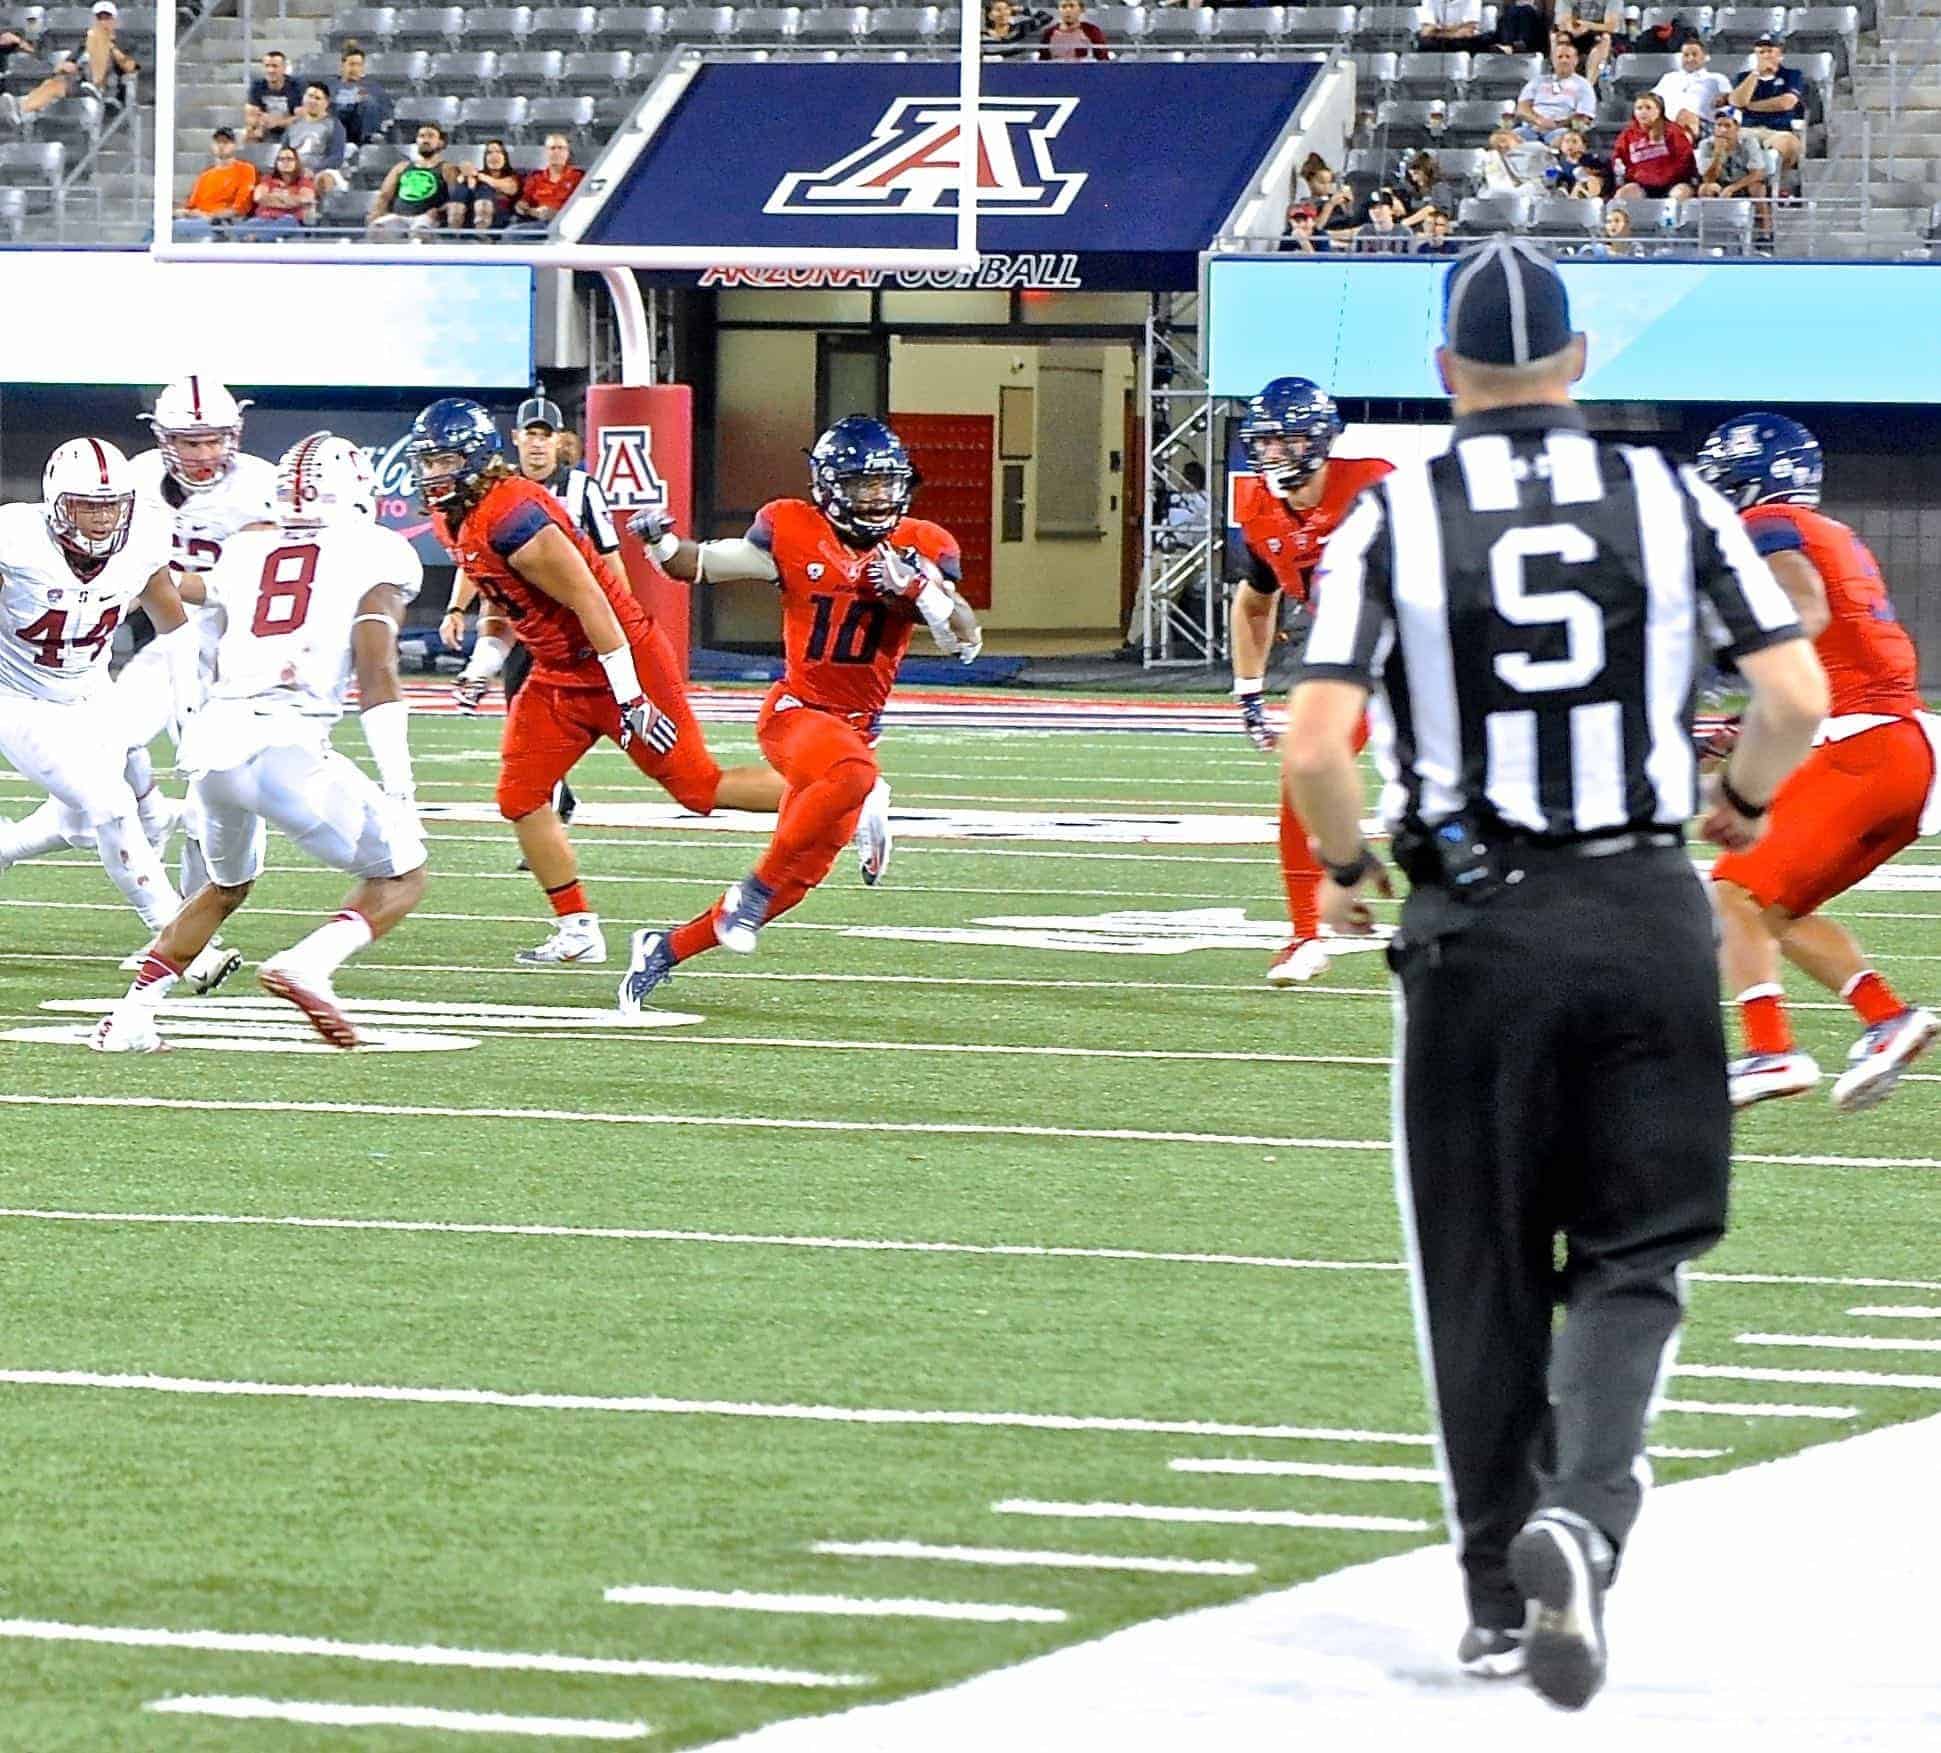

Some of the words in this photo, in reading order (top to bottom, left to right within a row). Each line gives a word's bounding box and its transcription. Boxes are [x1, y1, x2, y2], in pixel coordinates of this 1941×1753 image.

[596, 425, 668, 510] A
[251, 543, 321, 638] 8
[806, 594, 887, 664] 10
[1490, 523, 1605, 693] S
[15, 604, 121, 668] 44
